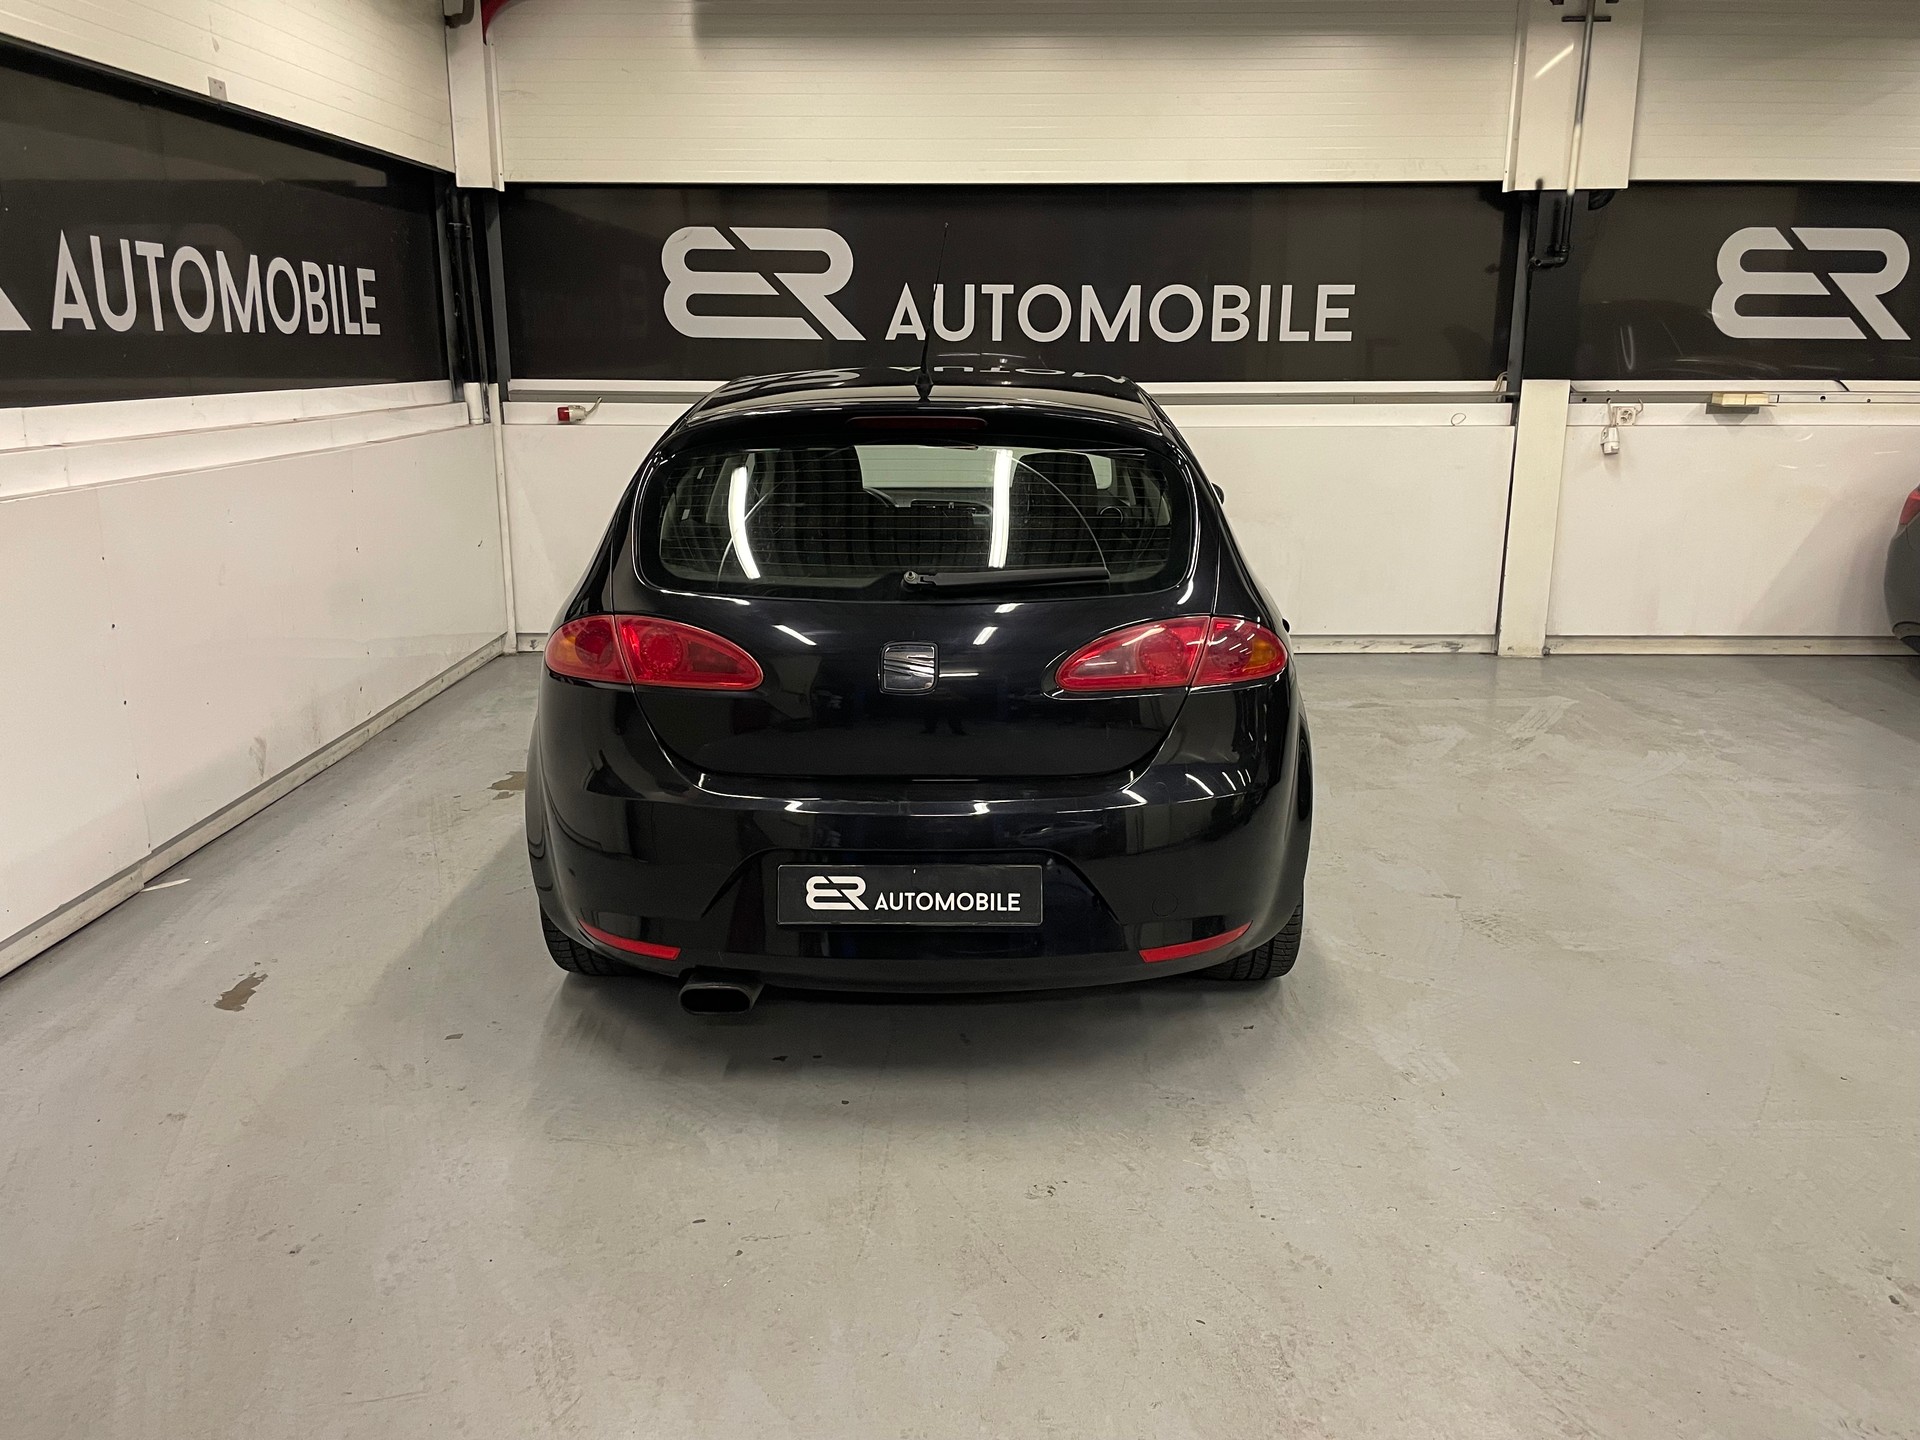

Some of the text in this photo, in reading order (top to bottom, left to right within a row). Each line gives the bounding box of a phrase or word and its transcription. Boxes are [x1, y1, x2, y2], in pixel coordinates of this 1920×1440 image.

[52, 230, 381, 335] AUTOMOBILE
[885, 283, 1356, 342] AUTOMOBILE
[875, 892, 1020, 911] AUTOMOBILE
